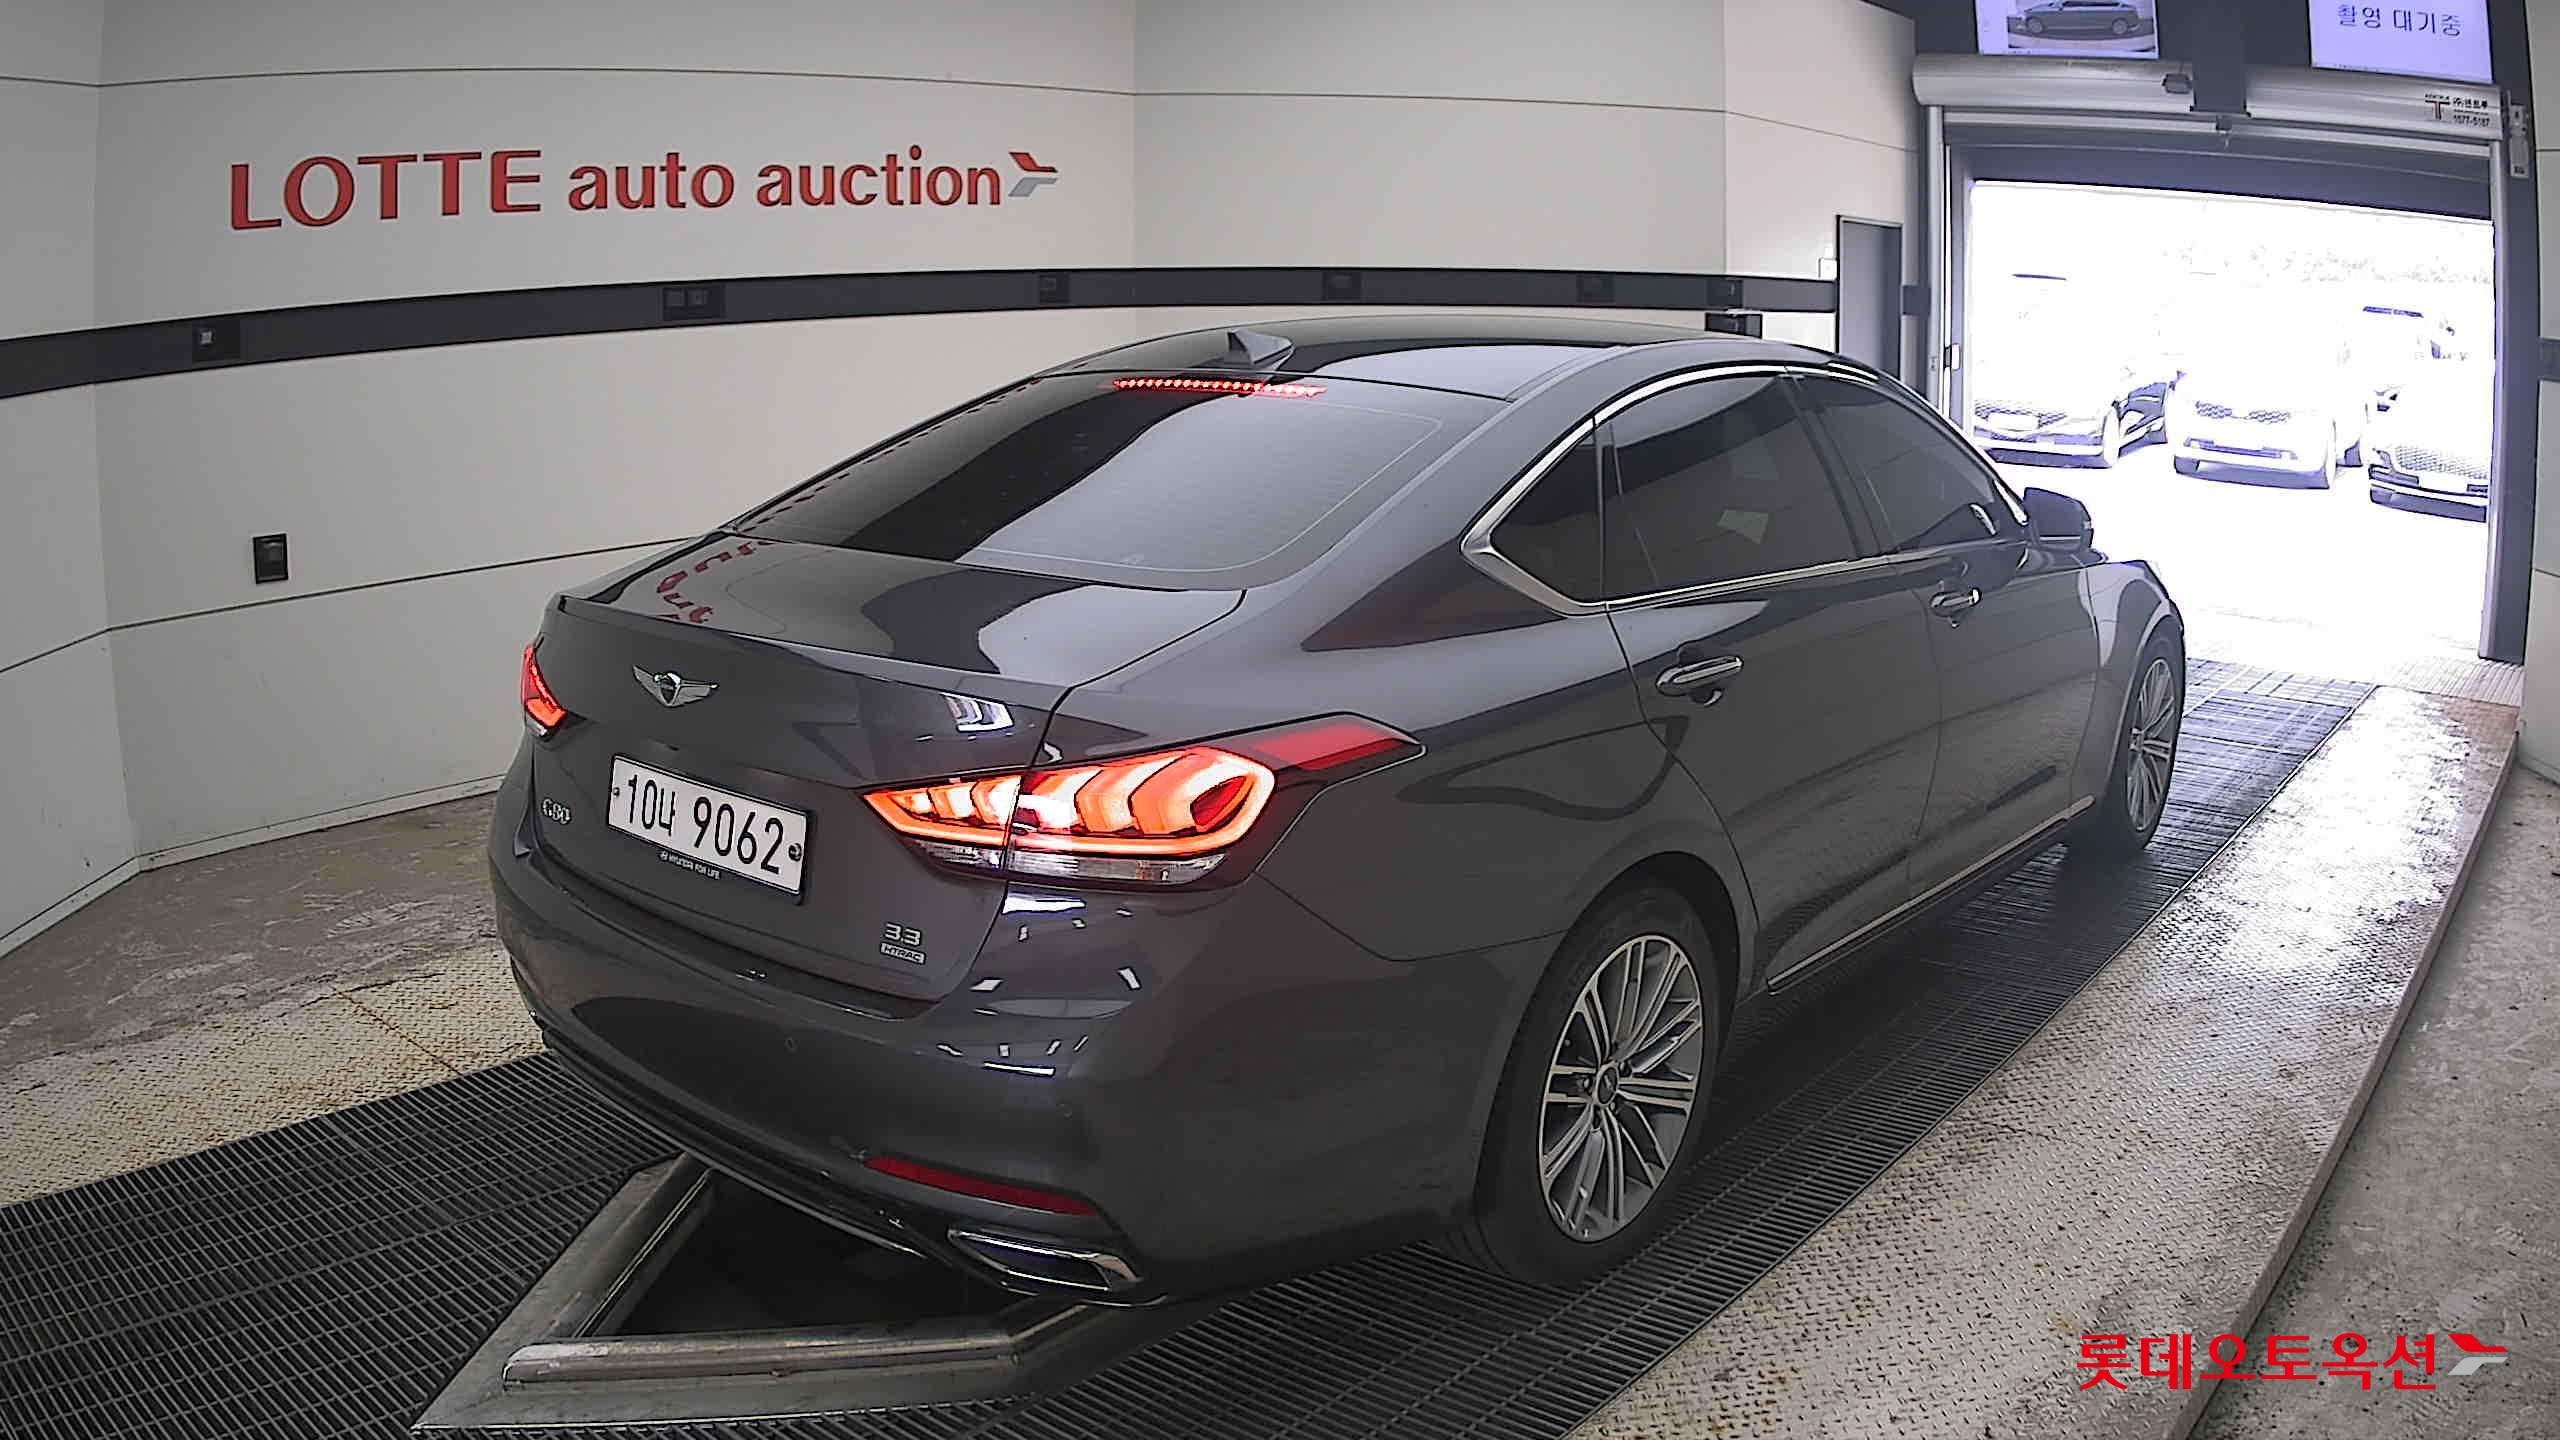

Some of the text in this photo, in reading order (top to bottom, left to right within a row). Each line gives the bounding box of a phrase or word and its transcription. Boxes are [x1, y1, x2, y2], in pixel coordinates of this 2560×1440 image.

[2393, 8, 2461, 37] 대기중
[229, 145, 1003, 230] LOTTE auto auction
[542, 798, 570, 825] G80
[693, 796, 785, 875] 9062
